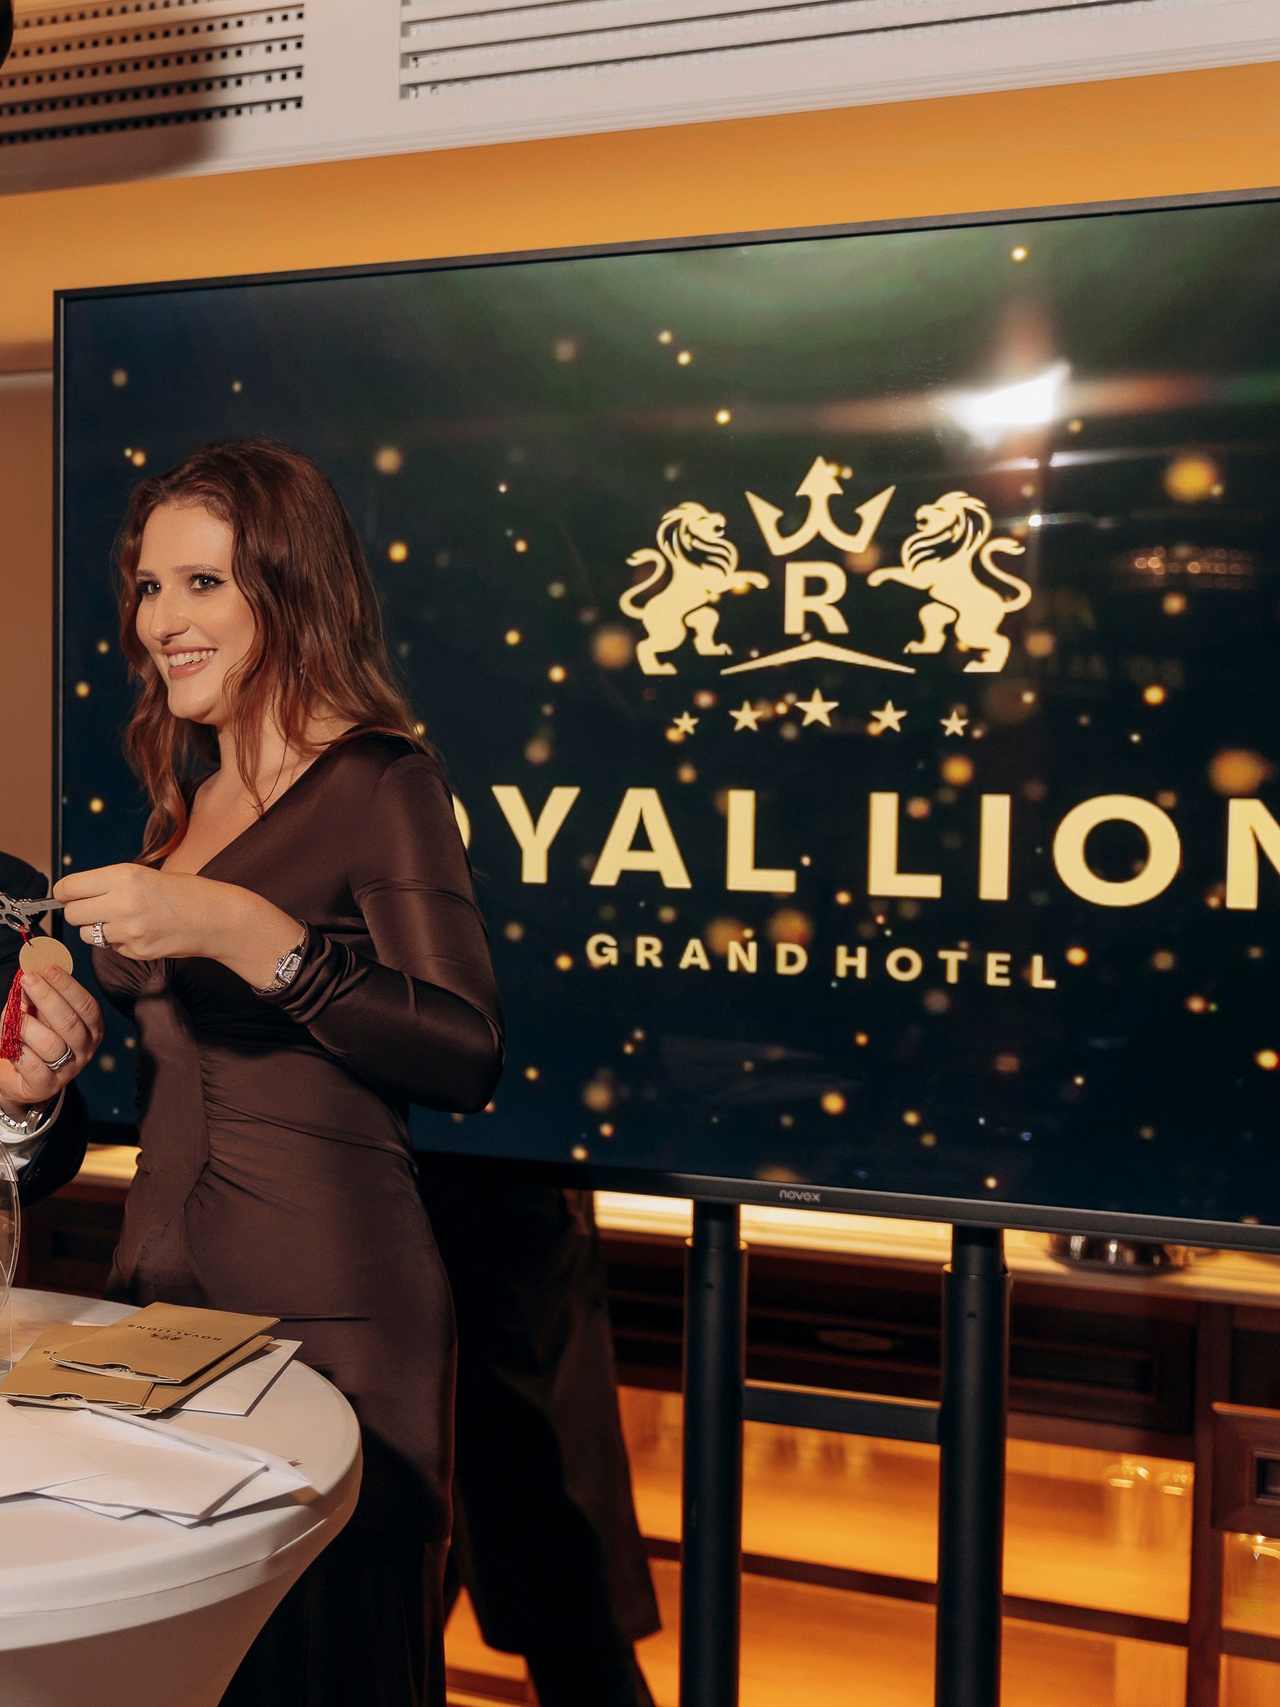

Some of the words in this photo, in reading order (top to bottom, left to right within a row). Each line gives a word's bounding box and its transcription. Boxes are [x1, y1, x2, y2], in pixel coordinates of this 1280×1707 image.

[784, 562, 849, 634] R
[451, 785, 797, 893] YAL
[586, 933, 809, 975] GRAND
[836, 946, 1057, 989] HOTEL
